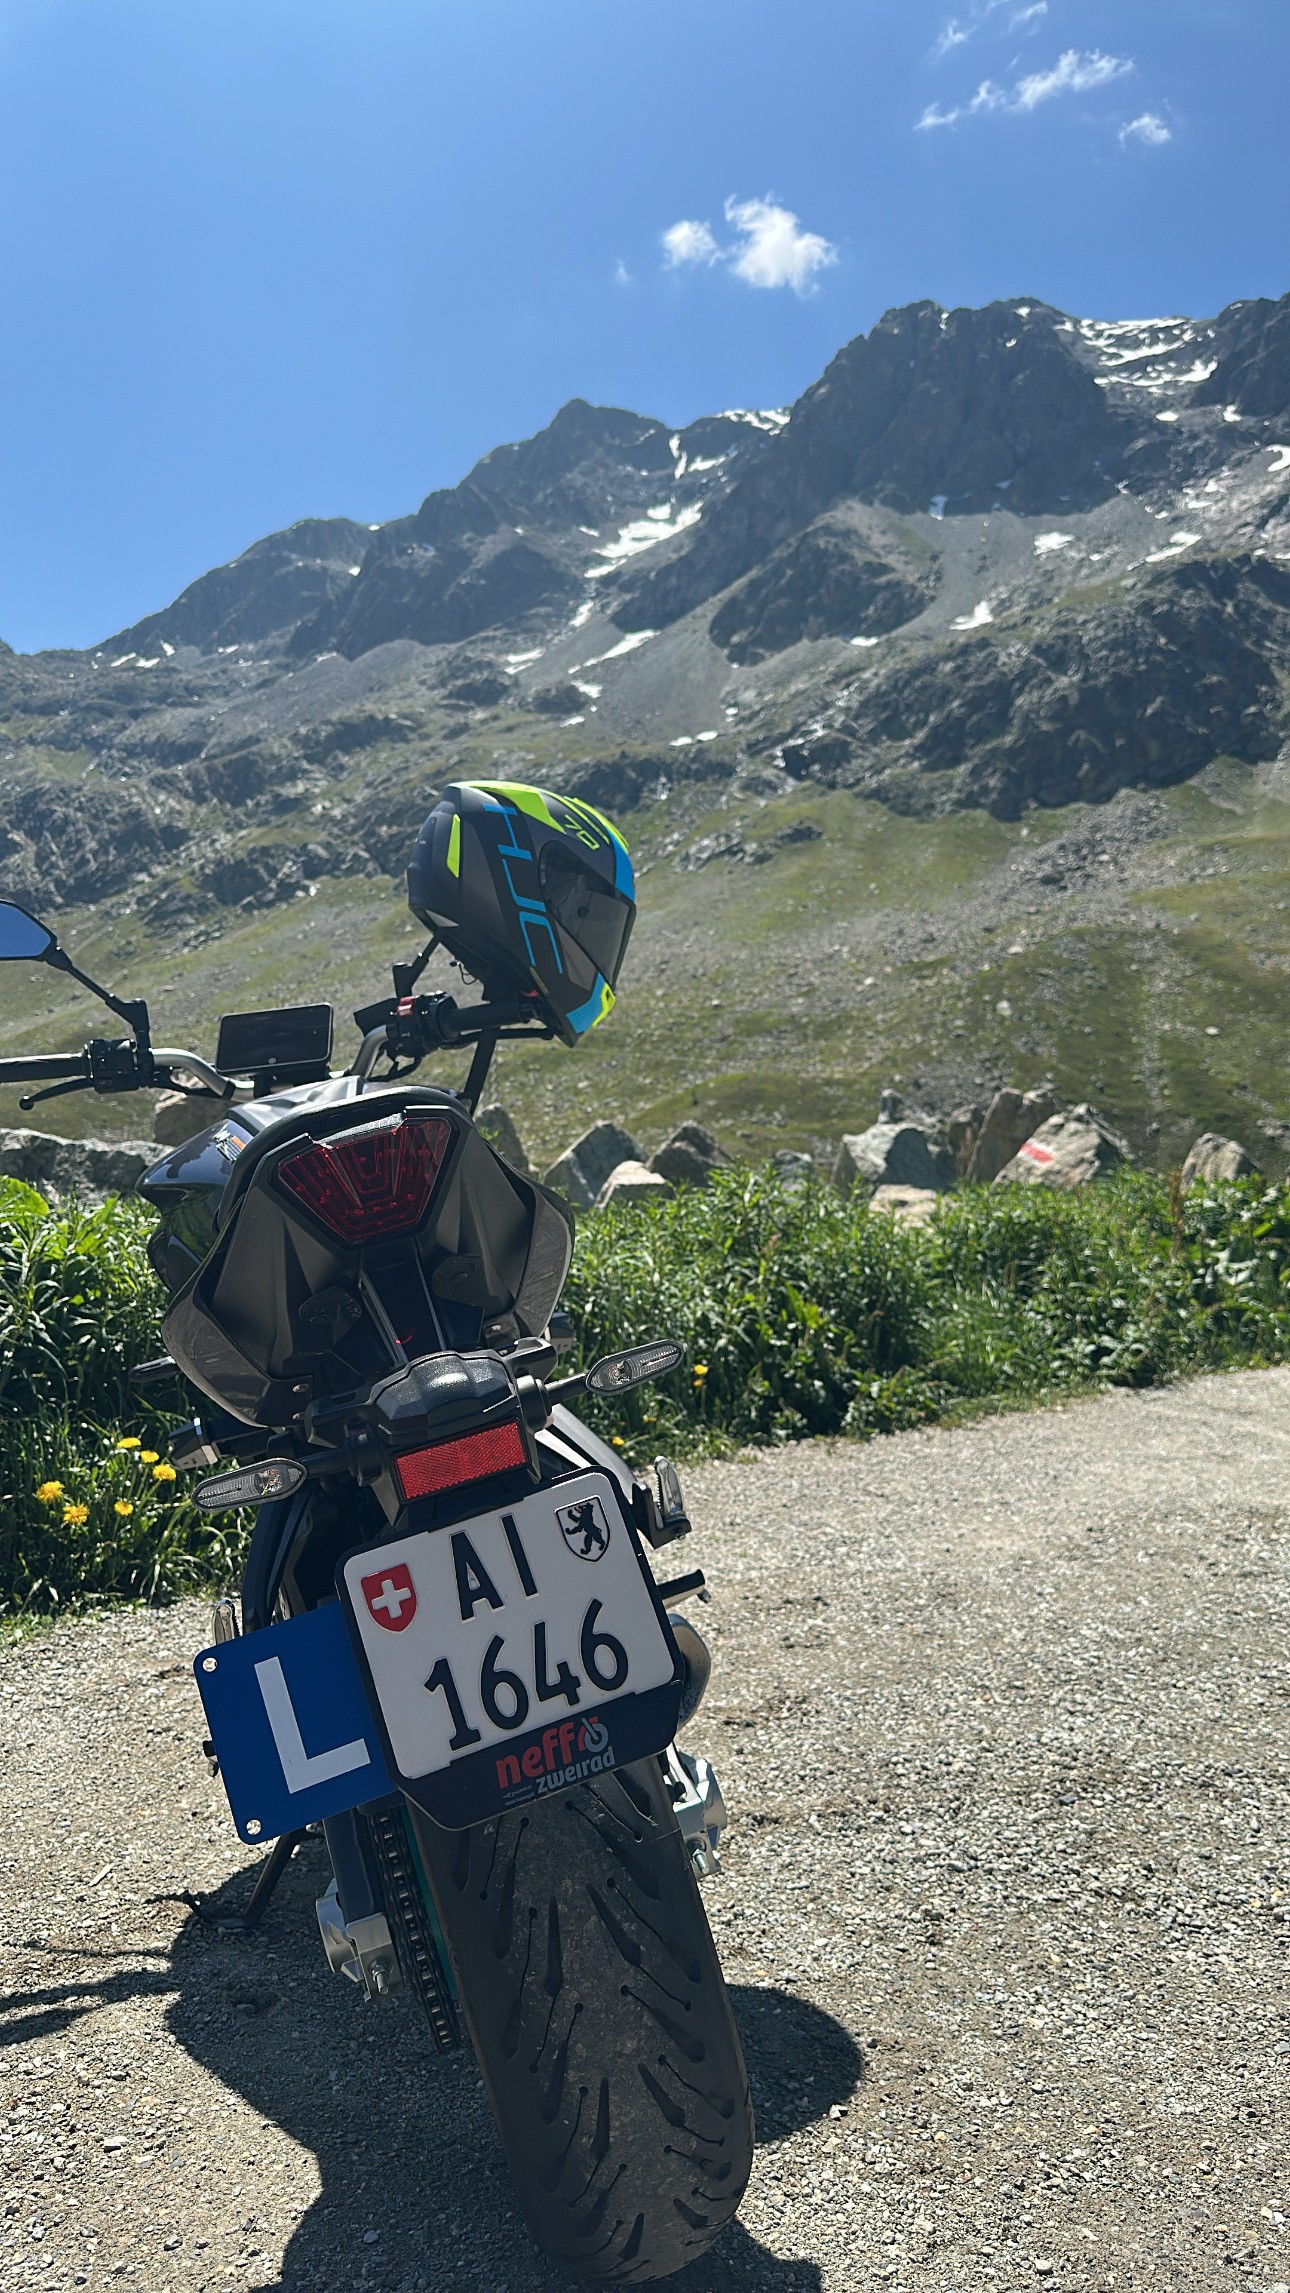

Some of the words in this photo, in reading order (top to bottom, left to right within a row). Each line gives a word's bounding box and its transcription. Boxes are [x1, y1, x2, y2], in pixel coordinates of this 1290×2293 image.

[450, 1514, 539, 1621] AI
[254, 1656, 371, 1794] L
[423, 1598, 629, 1750] 1646
[495, 1721, 575, 1789] neff
[536, 1745, 616, 1794] zweirad
